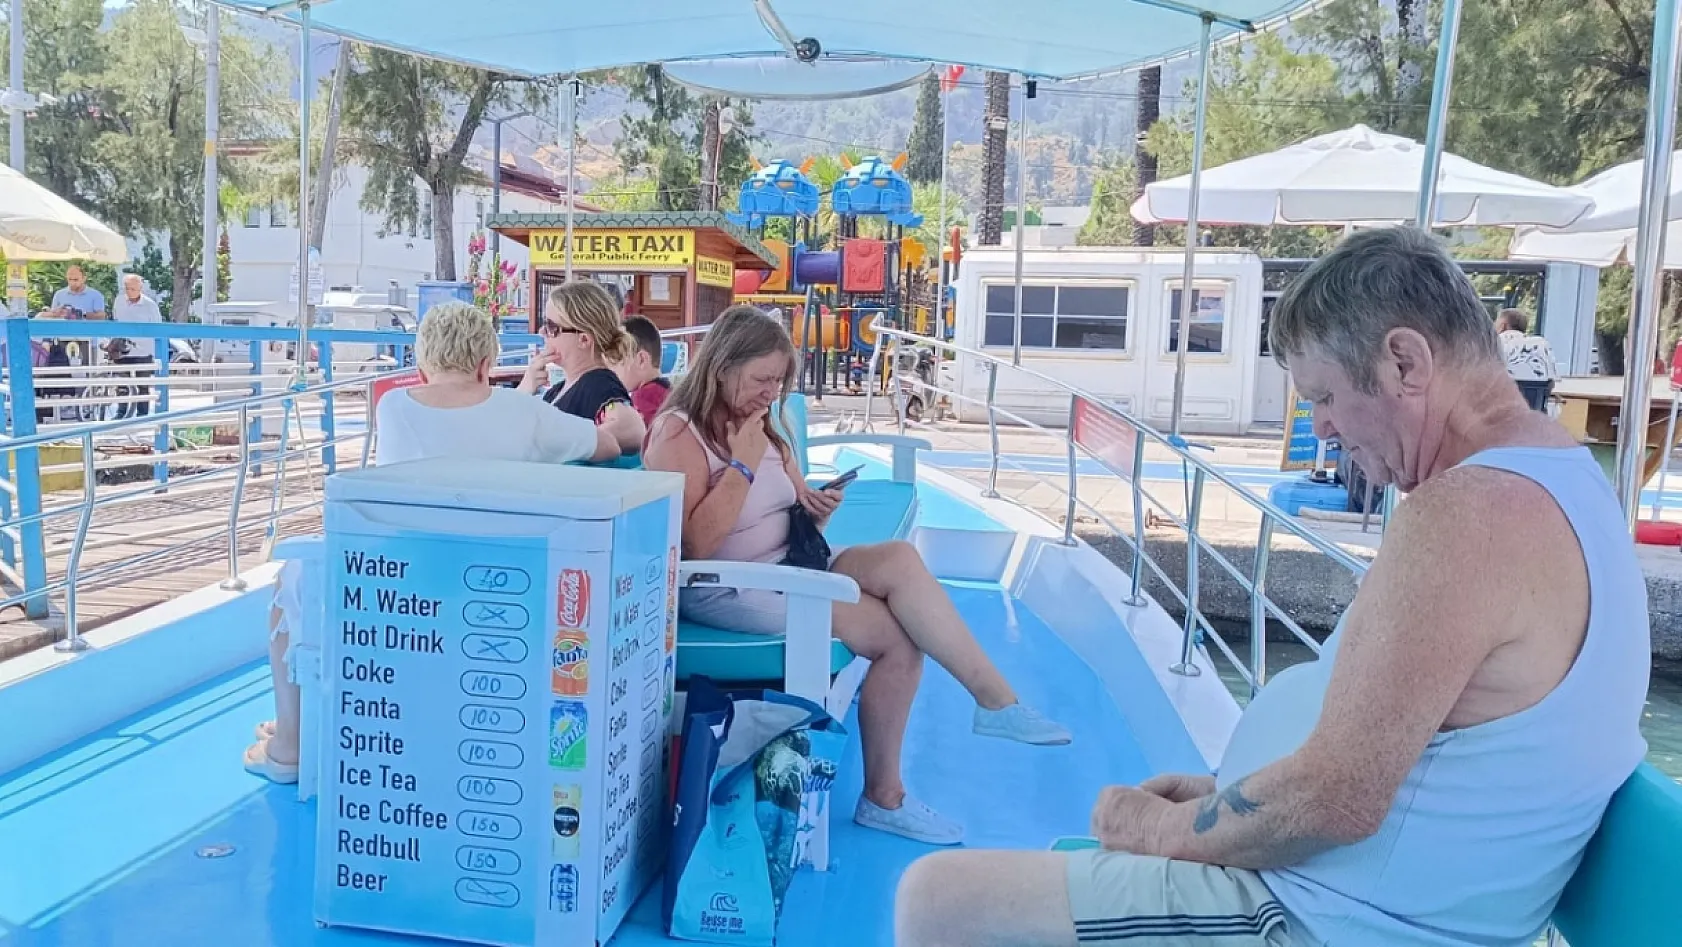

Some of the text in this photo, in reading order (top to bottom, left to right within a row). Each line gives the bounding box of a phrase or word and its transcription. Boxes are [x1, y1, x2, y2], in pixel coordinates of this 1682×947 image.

[534, 235, 684, 252] WATER TAXI
[550, 252, 670, 261] Geeral Public Ferry
[344, 550, 409, 579] Water
[343, 585, 442, 618] M. Water
[343, 620, 444, 654] Hot Drink
[342, 656, 395, 684] Coke
[471, 675, 501, 693] 100
[341, 690, 400, 720] Fanta
[471, 708, 501, 726] 100
[340, 725, 404, 757] Sprite
[468, 743, 497, 762] 100
[340, 760, 417, 792] Ice Tea
[466, 779, 496, 796] 100
[339, 794, 447, 830] Ice Coffee
[471, 816, 500, 833] 150
[338, 829, 421, 862] Redbull
[467, 849, 497, 869] 150
[337, 863, 388, 892] Beer
